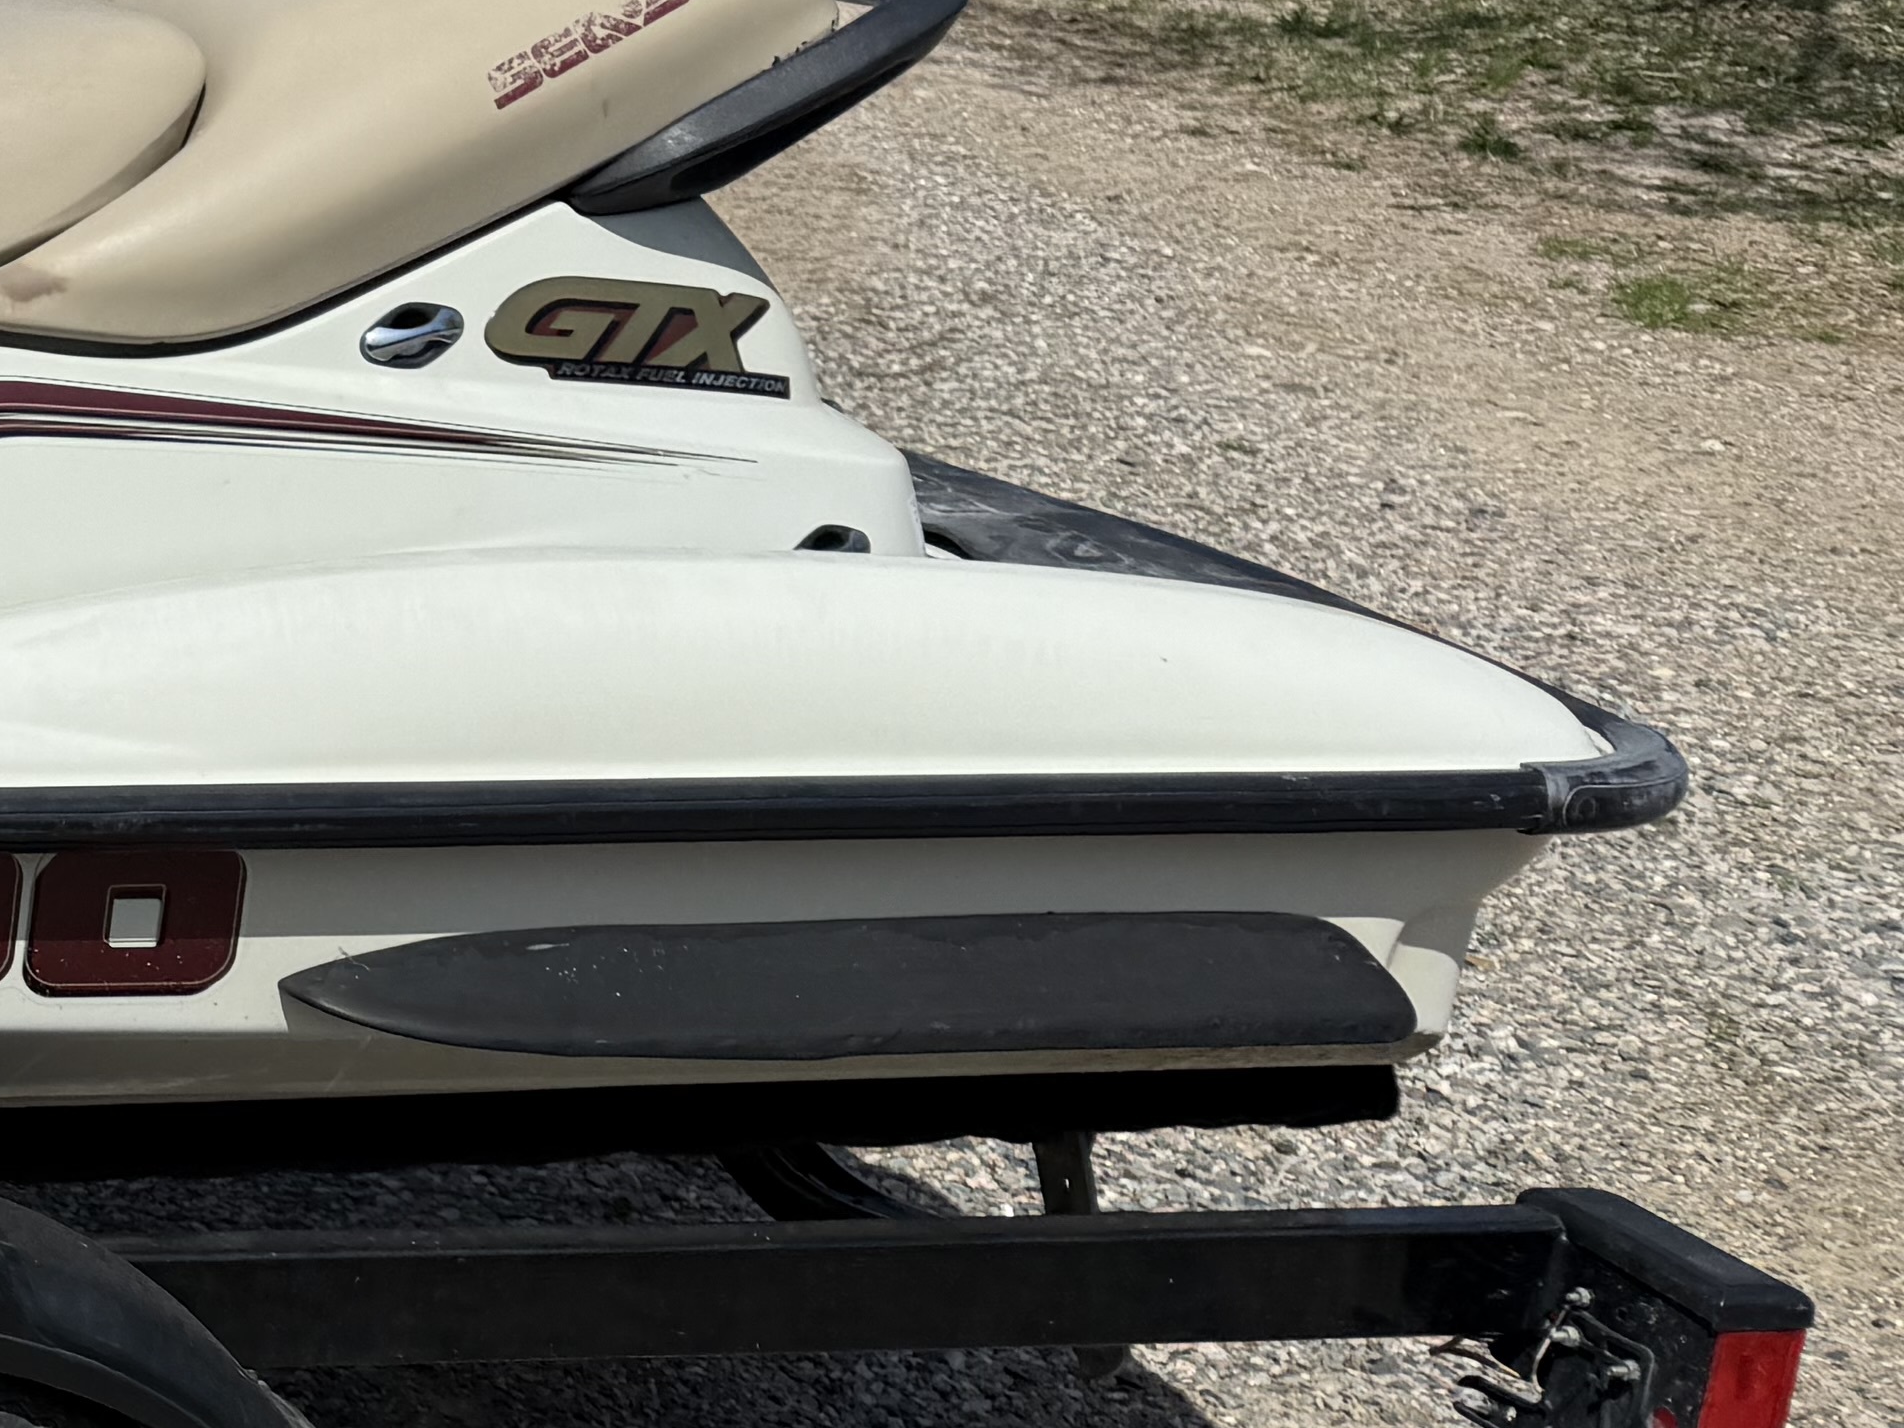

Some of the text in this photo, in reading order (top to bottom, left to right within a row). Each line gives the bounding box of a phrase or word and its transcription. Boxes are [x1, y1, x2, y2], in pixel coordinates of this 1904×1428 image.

[485, 276, 770, 372] GTX
[636, 367, 686, 384] FUEL
[691, 371, 786, 393] INJECTION
